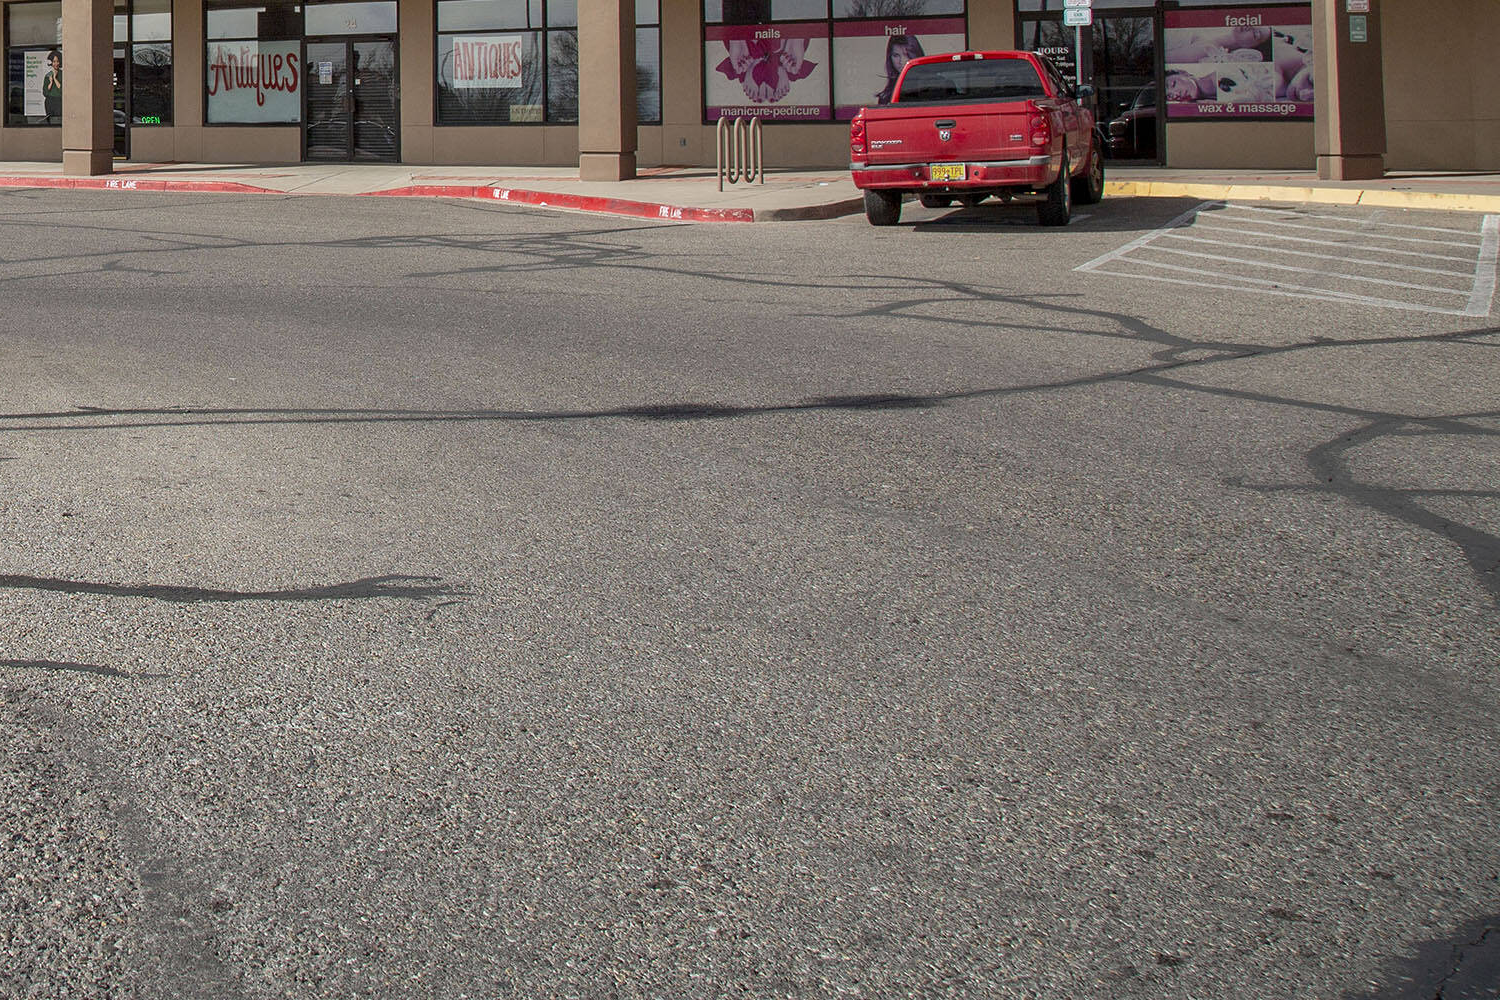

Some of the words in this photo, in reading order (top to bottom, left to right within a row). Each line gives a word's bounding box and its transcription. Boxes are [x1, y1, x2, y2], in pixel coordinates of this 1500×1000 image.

[1225, 14, 1262, 26] facial
[755, 28, 781, 39] nails
[884, 25, 907, 36] hair
[454, 41, 522, 80] ANTIQUES
[208, 46, 299, 107] Antiques
[1198, 104, 1222, 113] wax
[1226, 103, 1235, 112] &
[1239, 103, 1297, 114] massage
[141, 115, 161, 124] OPEN
[106, 180, 119, 188] FIRE
[121, 180, 137, 189] LANE
[659, 205, 669, 217] FIRE
[670, 207, 682, 218] LANE
